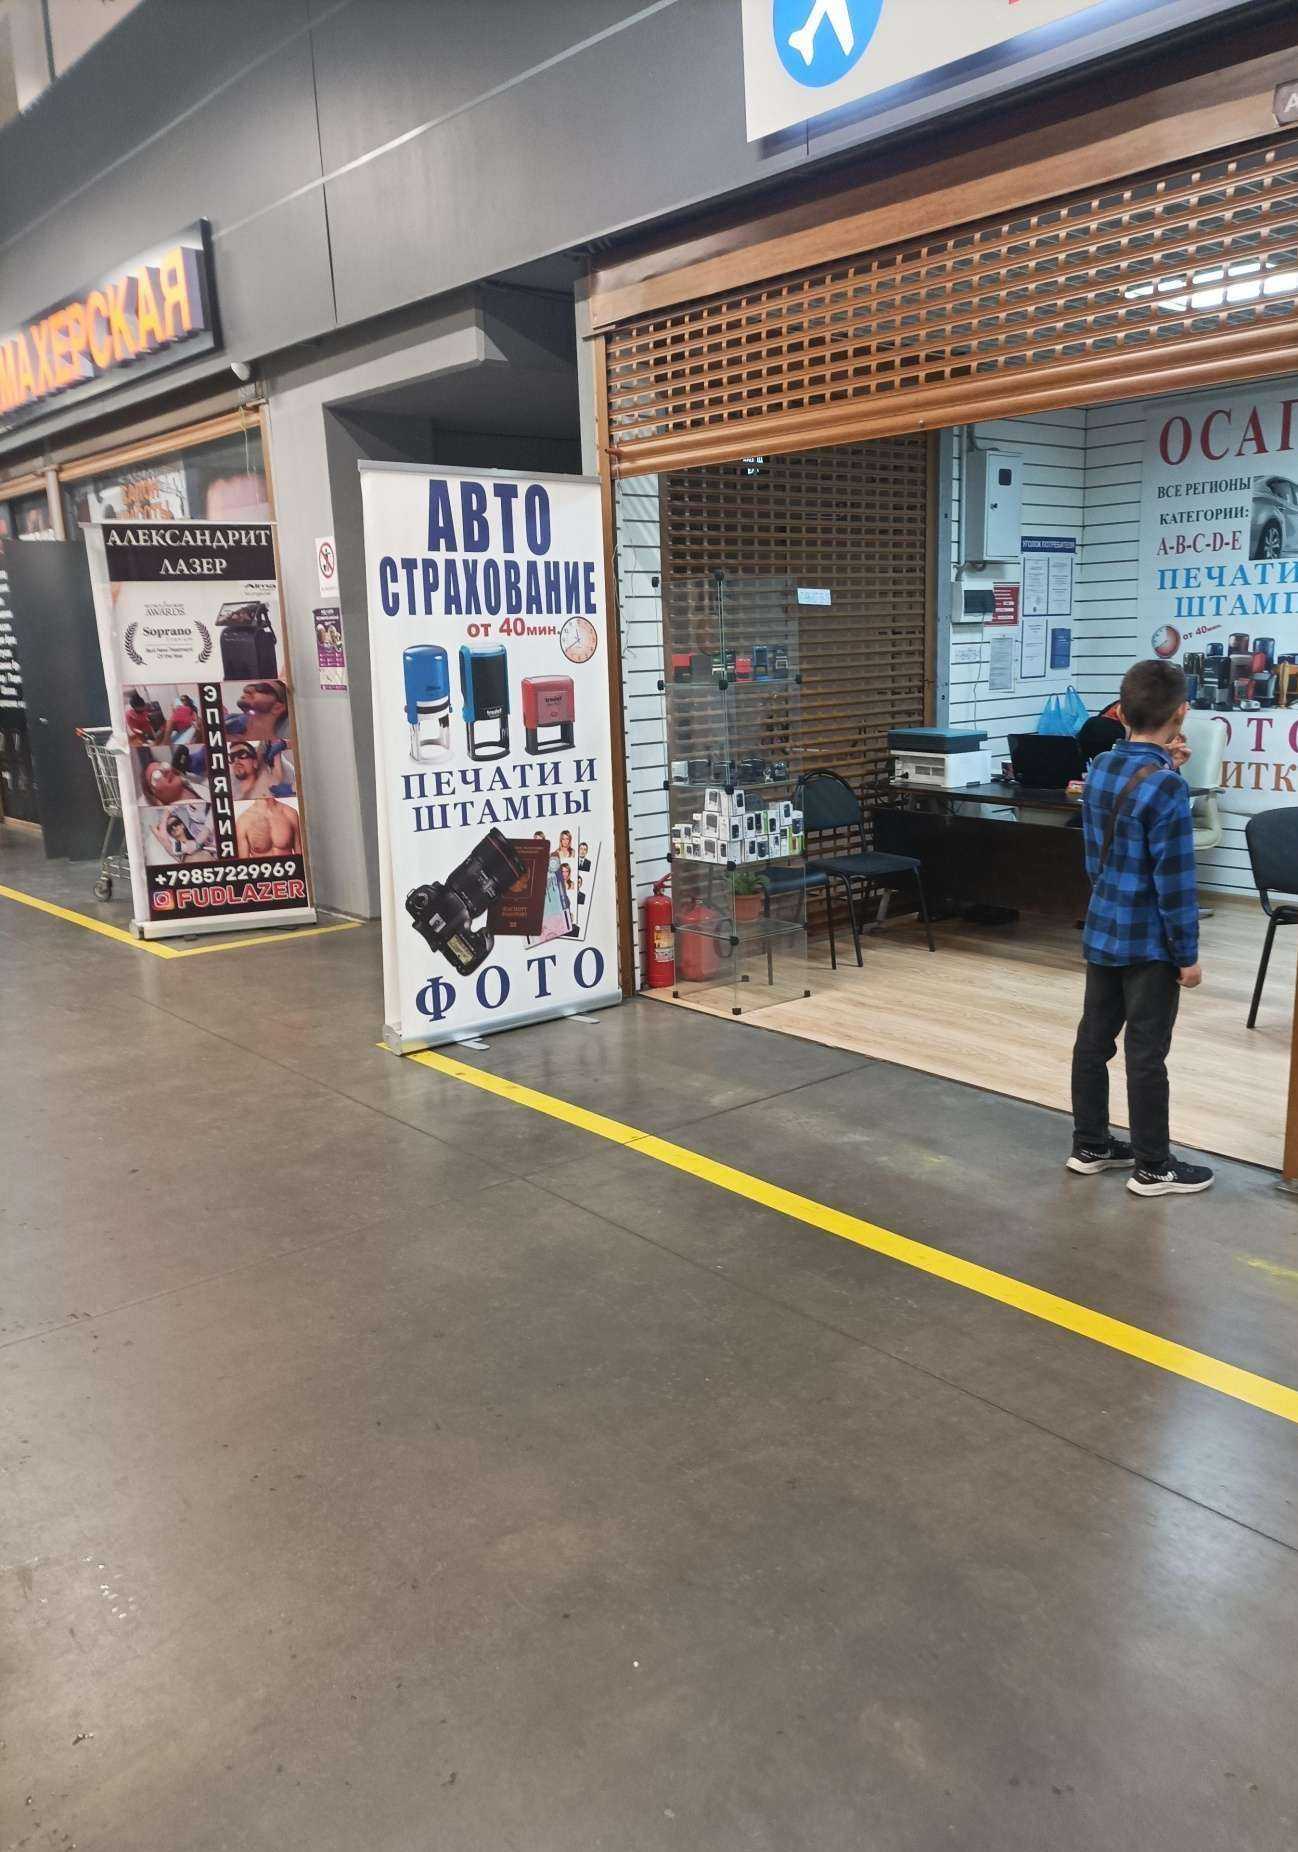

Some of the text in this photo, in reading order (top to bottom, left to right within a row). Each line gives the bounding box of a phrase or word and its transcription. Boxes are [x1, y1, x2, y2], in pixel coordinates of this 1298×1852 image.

[1157, 477, 1251, 499] ВСЕ РЕГИОНЫ
[428, 478, 551, 556] АВТО
[1159, 506, 1249, 526] КАТЕГОРИИ:
[106, 528, 270, 549] АЛЕКСАНДРИТ
[1156, 530, 1242, 556] A-B-C-D-E
[159, 557, 228, 575] ЛАЗЕР
[379, 555, 598, 617] СТРАХОВАНИЕ
[143, 626, 192, 639] Soprano
[467, 623, 492, 638] от
[203, 685, 235, 857] ЭПИЛЯЦИЯ
[401, 758, 598, 801] ПЕЧАТИ И
[412, 789, 592, 833] ШТАМПЫ
[154, 861, 297, 887] +79857229969
[176, 879, 306, 909] FUDLAZER
[415, 946, 605, 1023] ФОТО
